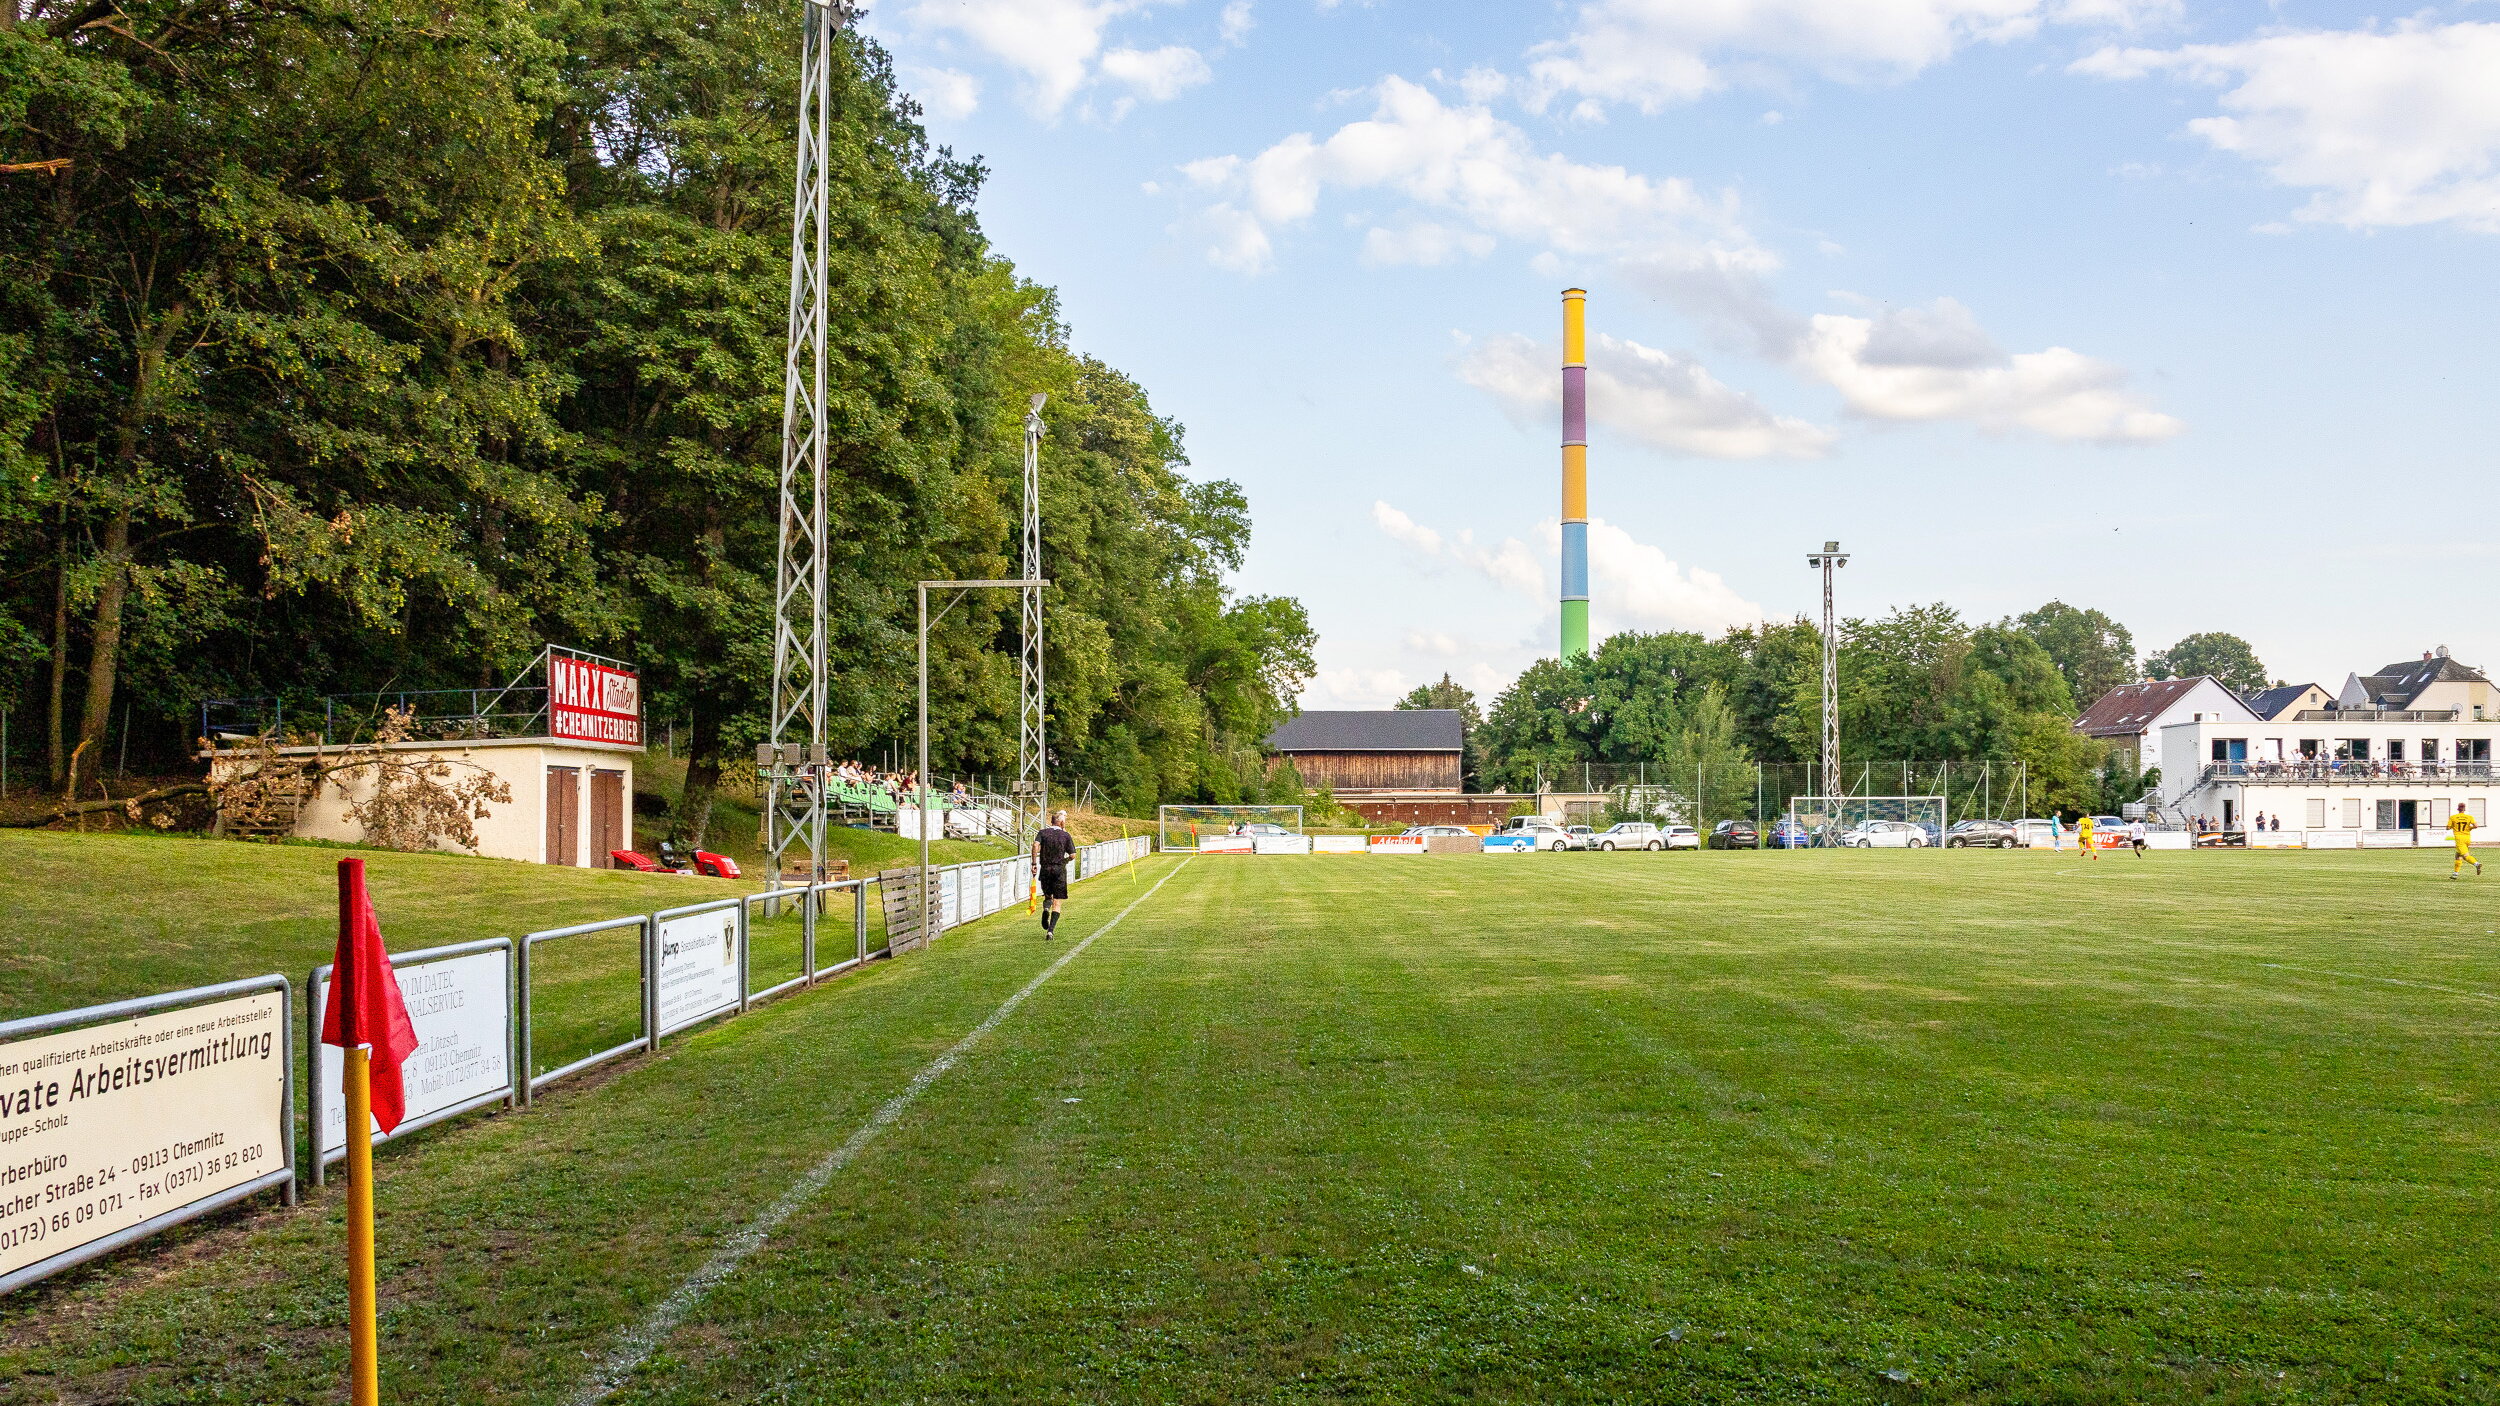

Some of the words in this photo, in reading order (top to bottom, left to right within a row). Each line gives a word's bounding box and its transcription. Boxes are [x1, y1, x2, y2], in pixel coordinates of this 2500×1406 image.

[554, 661, 600, 710] MARX
[556, 710, 638, 742] #CHEMNITZERBIER
[1377, 836, 1417, 845] Aderhold
[2456, 822, 2467, 831] 17
[425, 970, 454, 992] DATEC
[22, 1048, 87, 1075] qualifizierte
[89, 1032, 152, 1057] Arbeitskräfte
[155, 1026, 174, 1042] oder
[177, 1025, 194, 1037] eine
[196, 1020, 215, 1034] neue
[217, 1007, 273, 1028] Arbeitsstelle?
[69, 1031, 272, 1102] Arbeitsvermittlung
[425, 1052, 448, 1073] 09113
[450, 1044, 482, 1066] Chemnitz
[0, 1114, 69, 1144] uppe-Scholz
[1, 1154, 67, 1187] rberbüro
[46, 1174, 94, 1204] Straße
[99, 1166, 116, 1186] 24
[132, 1149, 169, 1175] 09113
[173, 1131, 224, 1160] Chemnitz
[0, 1216, 46, 1252] 0173)
[52, 1211, 70, 1232] 66
[76, 1203, 93, 1224] 09
[100, 1193, 123, 1215] 071
[139, 1181, 160, 1201] Fax
[164, 1162, 203, 1194] (0371)
[207, 1158, 221, 1176] 36
[225, 1152, 238, 1170] 92
[242, 1144, 263, 1165] 820
